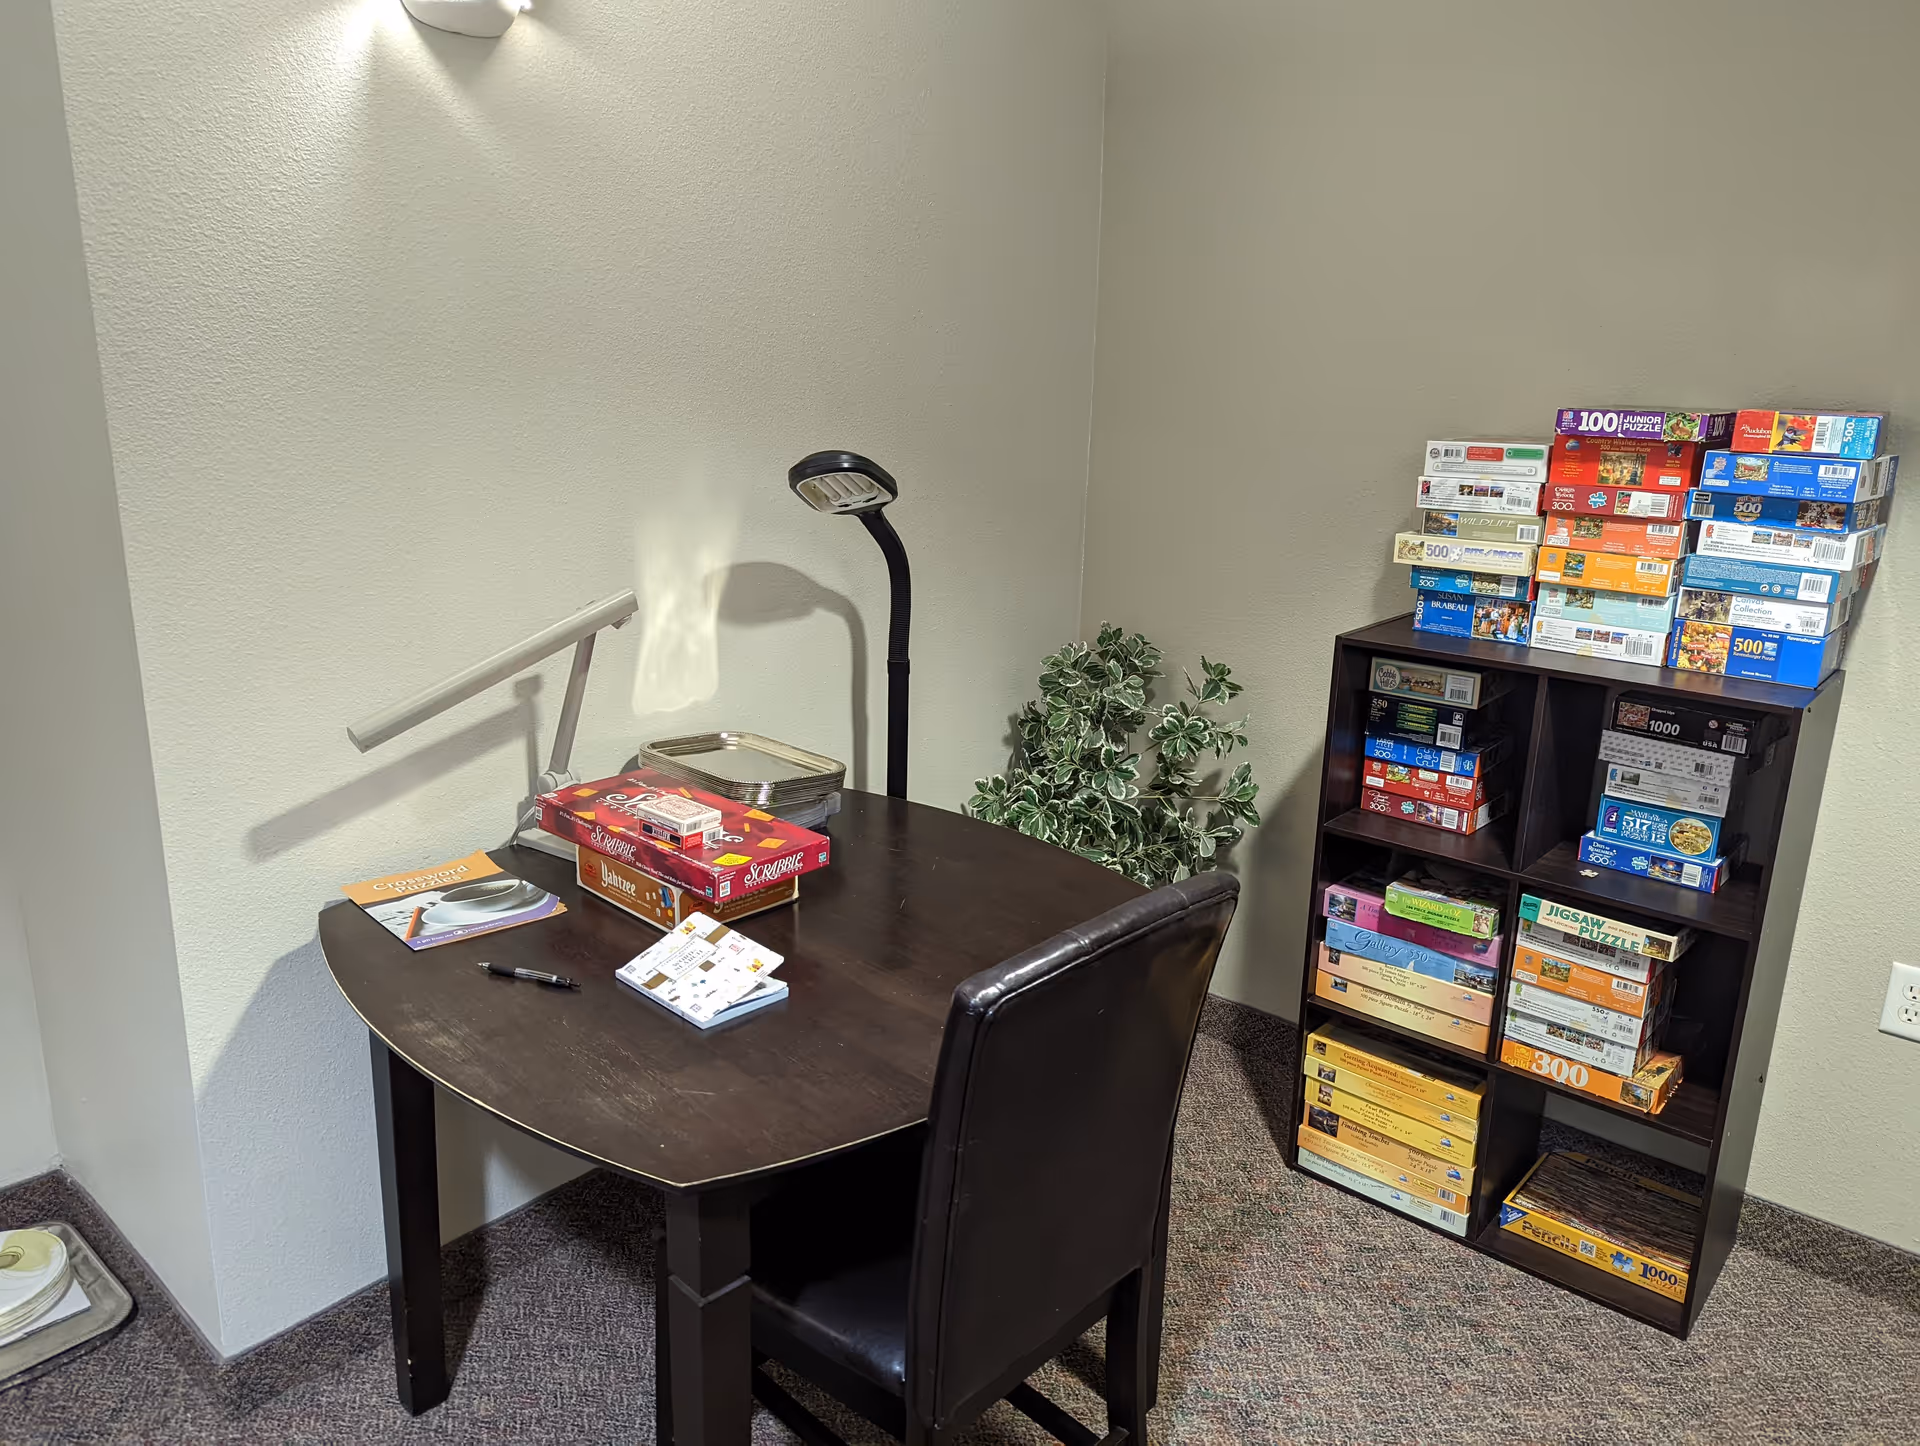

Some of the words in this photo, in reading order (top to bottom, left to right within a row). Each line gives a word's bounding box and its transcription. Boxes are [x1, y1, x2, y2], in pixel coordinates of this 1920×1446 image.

[1578, 411, 1619, 433] 100
[1624, 415, 1662, 424] JUNIOR
[1713, 415, 1726, 437] 100
[1622, 423, 1662, 432] PUZZLE
[1843, 422, 1855, 442] 500
[1586, 437, 1611, 445] Country
[1551, 502, 1572, 511] 300
[1734, 502, 1762, 513] 500
[1460, 517, 1516, 528] WILDLIFE
[1426, 544, 1449, 558] 500
[1438, 592, 1464, 601] SUSAN
[1735, 596, 1765, 605] Canvas
[1415, 600, 1425, 620] 500
[1431, 601, 1468, 612] BRABEAU
[1733, 604, 1773, 615] Collection
[1733, 637, 1763, 655] 500
[1786, 636, 1821, 645] Ravensburger
[1372, 698, 1388, 709] 550
[1649, 720, 1680, 736] 1000
[1702, 740, 1718, 749] USA
[1373, 749, 1390, 759] 300
[1369, 801, 1386, 812] 300
[1622, 815, 1652, 831] 517
[590, 825, 636, 858] SCRABBLE
[1651, 832, 1666, 844] 12
[1588, 854, 1609, 865] 500
[744, 851, 804, 884] SCRABBLE
[373, 865, 470, 891] Crossword
[394, 874, 462, 893] Puzzles
[600, 859, 637, 897] Yahtzee
[1411, 898, 1444, 912] WIZARD
[1449, 907, 1461, 917] OZ
[1443, 913, 1460, 923] PUZZLE
[1546, 904, 1606, 930] JIGSAW
[1345, 930, 1404, 959] Gallery
[1578, 925, 1641, 953] PUZZLE
[1592, 1006, 1605, 1015] 550
[1343, 1052, 1366, 1067] Getting
[1531, 1052, 1589, 1088] 300
[1340, 1120, 1367, 1138] Finishing
[1368, 1132, 1390, 1146] Touches
[1522, 1220, 1578, 1254] Pencils
[1639, 1262, 1678, 1286] 1000
[1649, 1277, 1685, 1296] PUZZLE
